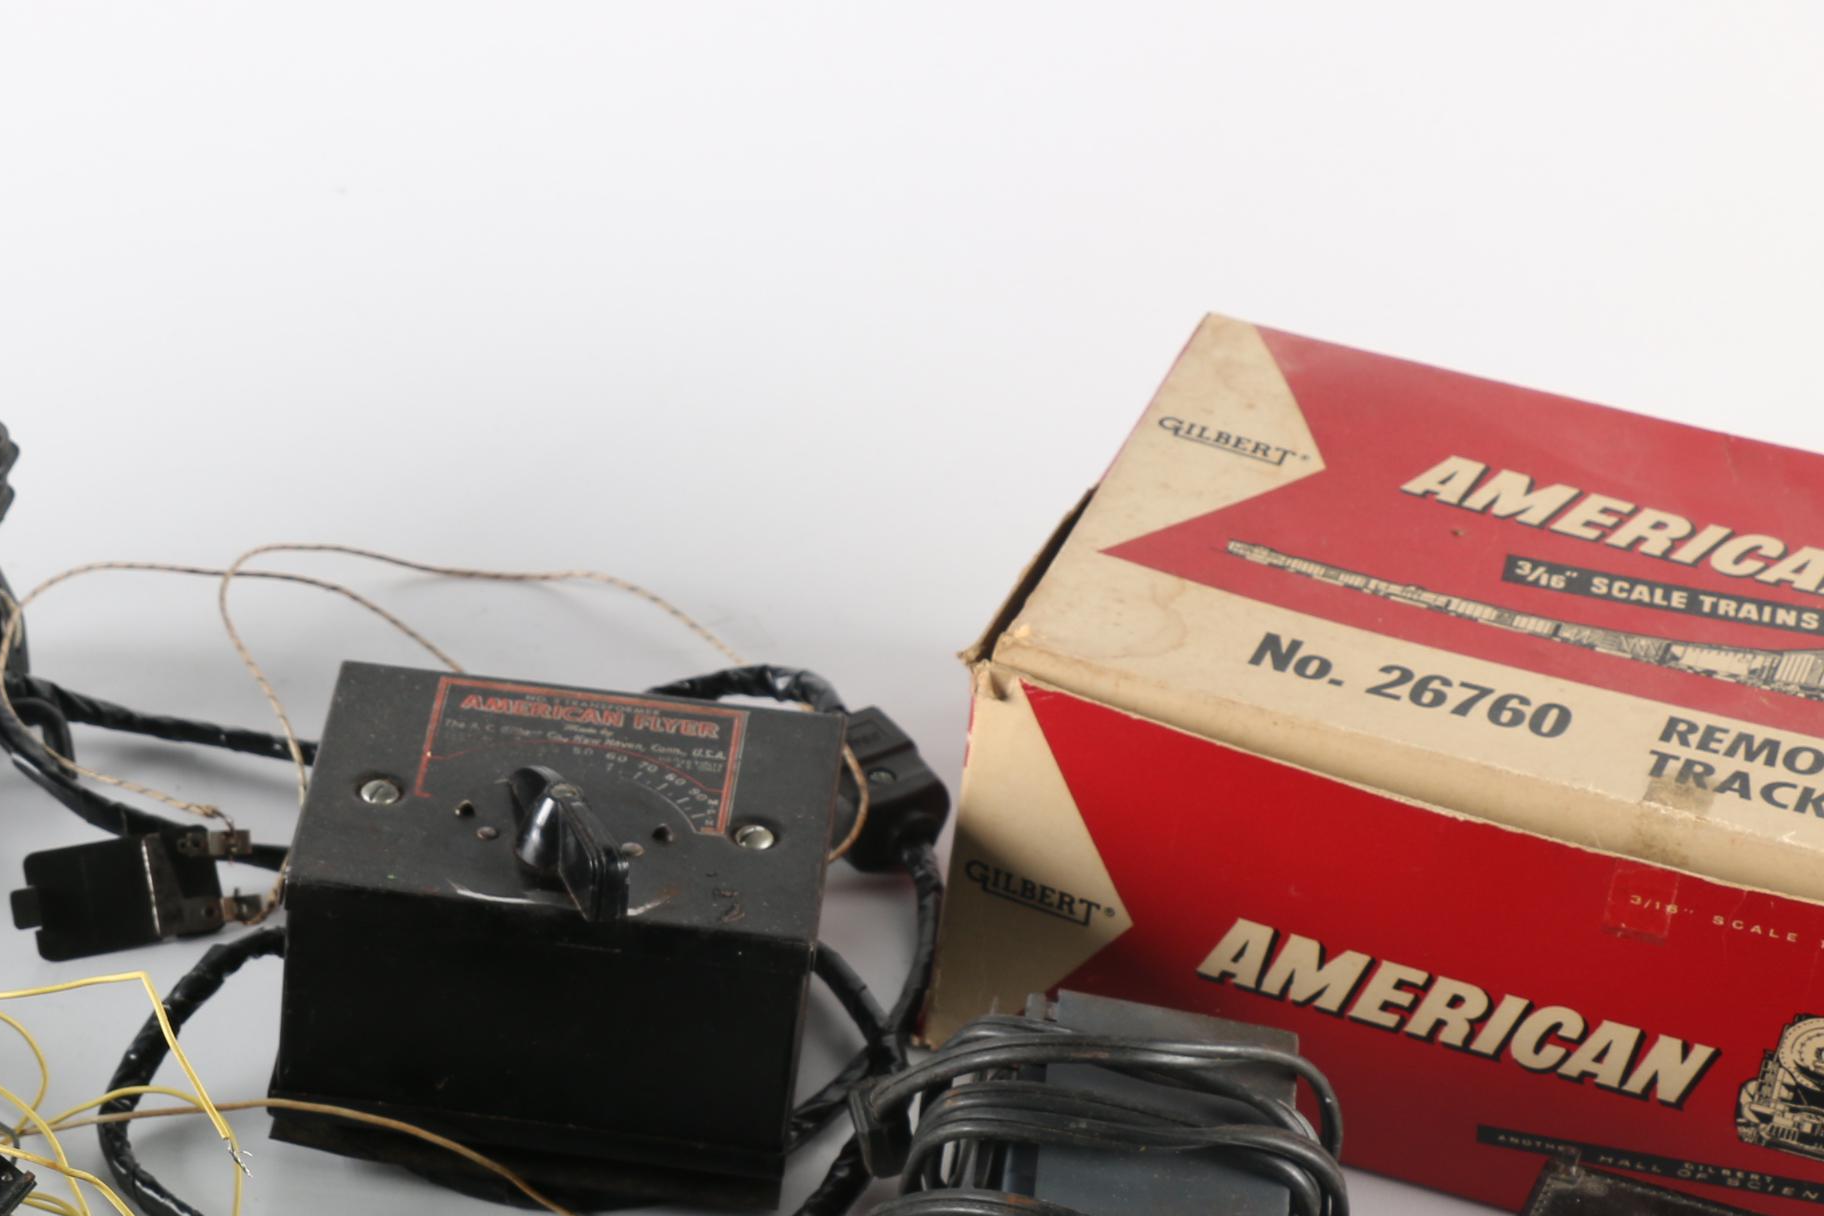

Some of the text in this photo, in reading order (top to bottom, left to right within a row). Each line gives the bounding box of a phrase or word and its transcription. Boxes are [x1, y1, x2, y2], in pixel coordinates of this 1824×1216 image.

[1399, 454, 1824, 595] AMERICA
[1590, 576, 1688, 609] SCALE
[1698, 593, 1821, 632] TRAINS
[1246, 632, 1573, 739] No. 26760
[460, 693, 720, 739] AMERICAN FLYER
[1657, 716, 1824, 778] REMO
[1712, 915, 1799, 943] SCALE
[1196, 917, 1721, 1110] AMERICAN
[1599, 1155, 1662, 1173] HALL
[1725, 1176, 1821, 1200] SCIEN
